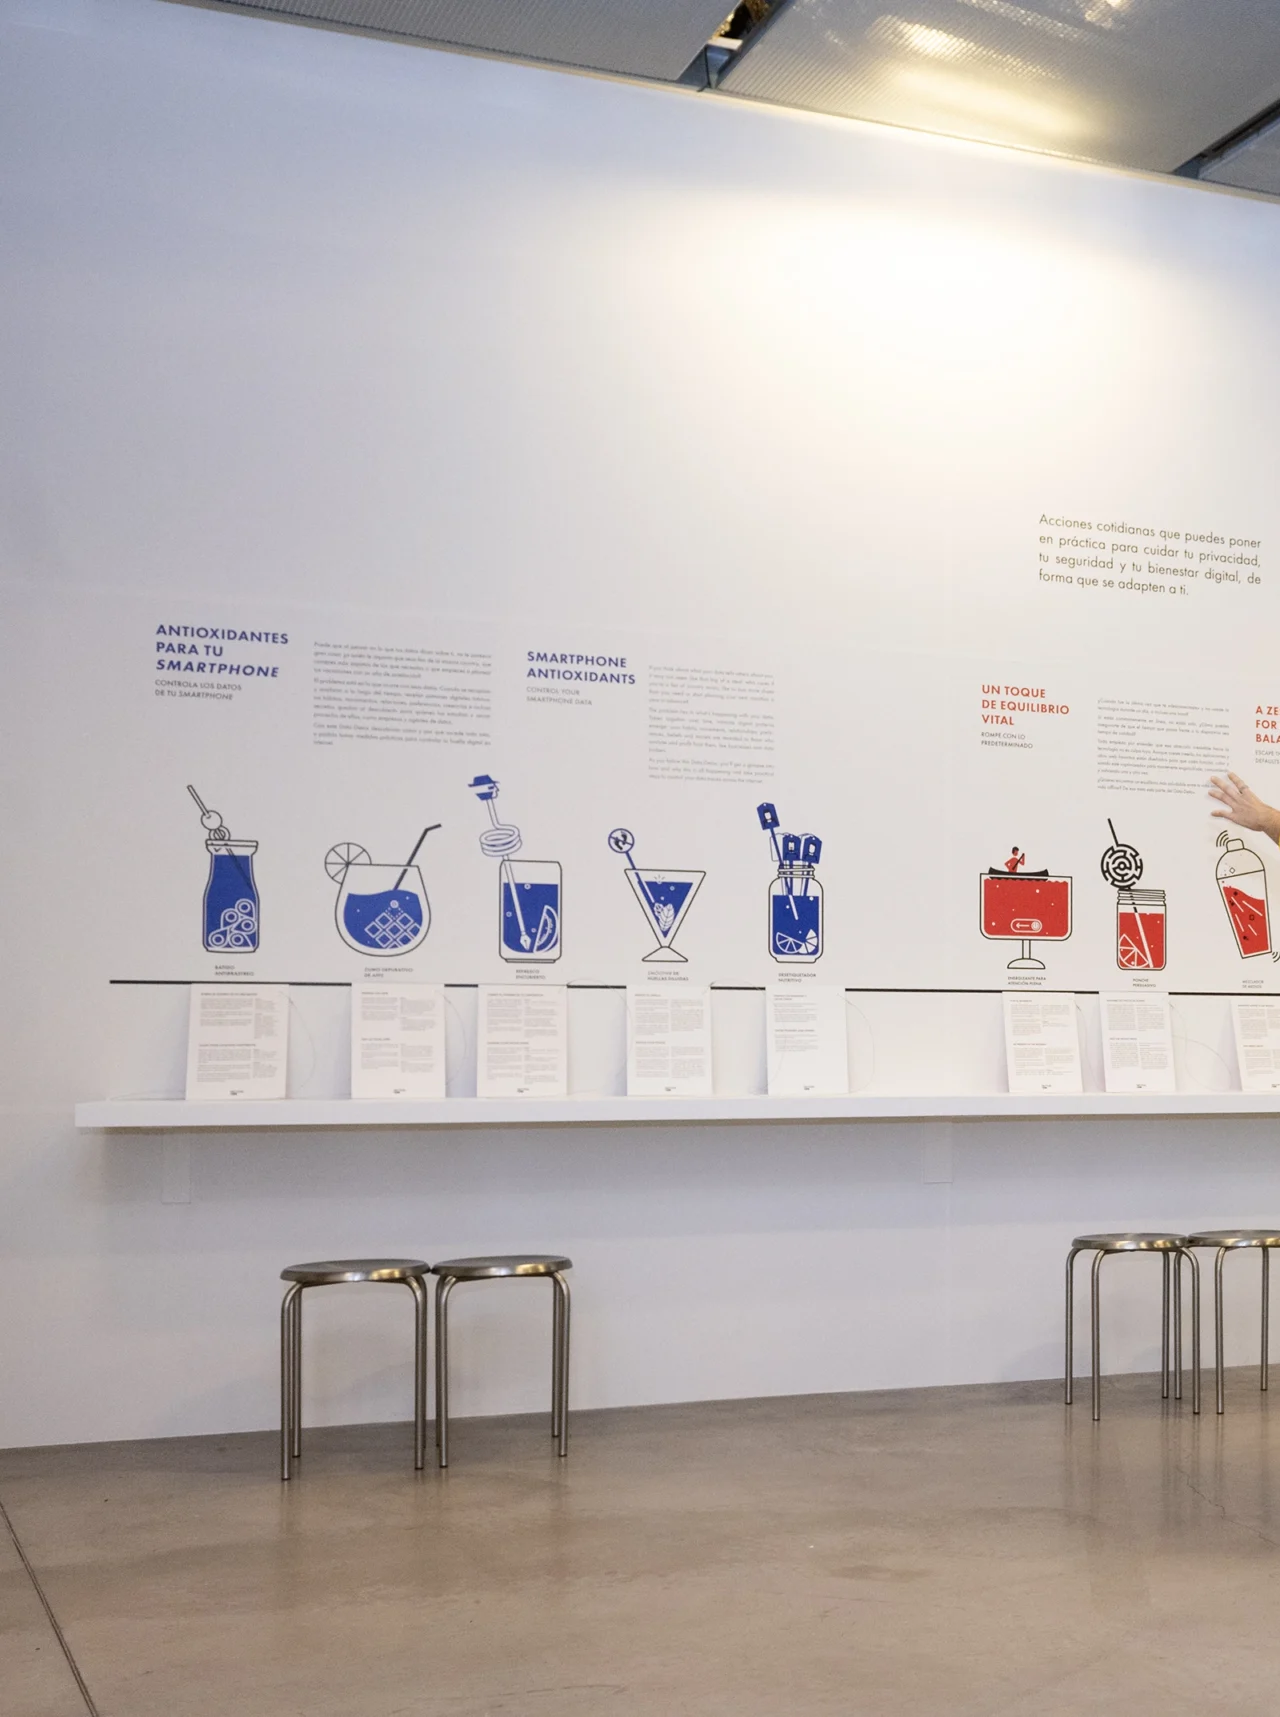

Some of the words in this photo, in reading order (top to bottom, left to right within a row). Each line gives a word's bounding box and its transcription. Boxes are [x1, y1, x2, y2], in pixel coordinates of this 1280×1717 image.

[1039, 514, 1092, 530] Acciones
[1097, 522, 1155, 537] cotidianas
[1160, 529, 1180, 541] que
[1185, 532, 1225, 545] puedes
[1229, 538, 1261, 549] poner
[1039, 536, 1053, 544] en
[1059, 536, 1106, 550] práctica
[1112, 542, 1138, 554] para
[1144, 544, 1179, 558] cuidar
[1184, 550, 1194, 560] tu
[1200, 552, 1261, 568] privacidad,
[1039, 553, 1049, 563] tu
[1056, 554, 1114, 570] seguridad
[1120, 562, 1126, 573] y
[1132, 562, 1142, 572] tu
[1148, 562, 1199, 579] bienestar
[1205, 568, 1241, 584] digital,
[1247, 574, 1261, 585] de
[1039, 569, 1073, 584] forma
[1077, 576, 1098, 588] que
[1103, 579, 1114, 588] se
[1118, 580, 1165, 594] adapten
[1169, 586, 1176, 595] a
[1180, 586, 1189, 595] ti.
[156, 624, 289, 644] ANTIOXIDANTES
[156, 642, 199, 655] PARA
[204, 645, 224, 657] TU
[527, 651, 627, 668] SMARTPHONE
[156, 659, 280, 678] SMARTPHONE
[527, 668, 636, 685] ANTIOXIDANTS
[155, 679, 198, 688] CONTROLA
[217, 683, 242, 691] DATOS
[526, 686, 560, 694] CONTROL
[982, 684, 1001, 694] UN
[1005, 686, 1046, 698] TOQUE
[178, 691, 233, 700] SMARTPHONE
[526, 696, 573, 705] SMARTPHONE
[982, 700, 997, 709] DE
[1001, 701, 1069, 715] EQUILIBRIO
[1256, 705, 1263, 715] A
[982, 714, 1014, 725] VITAL
[1256, 720, 1277, 730] FOR
[981, 741, 1033, 749] PREDETERMINADO
